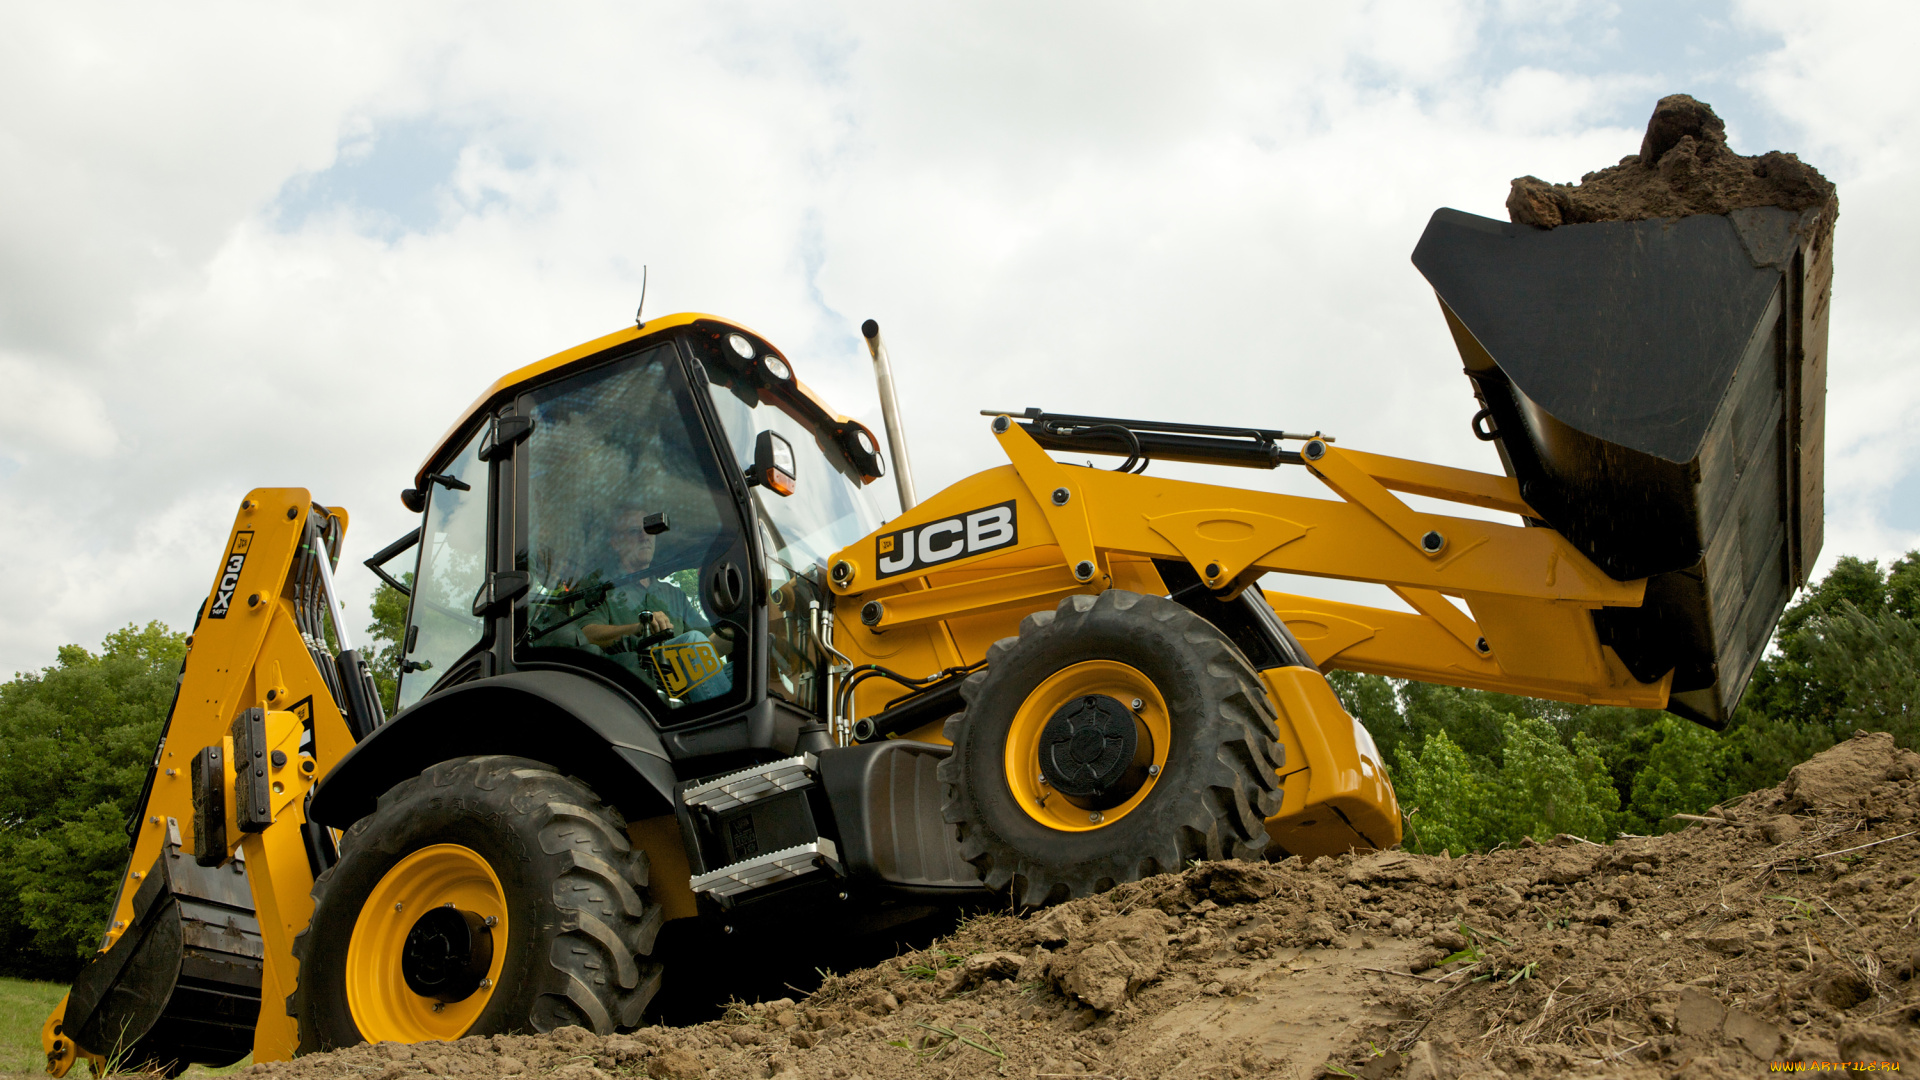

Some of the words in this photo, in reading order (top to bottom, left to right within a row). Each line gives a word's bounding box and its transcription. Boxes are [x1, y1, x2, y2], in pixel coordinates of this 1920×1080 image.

[880, 507, 1014, 574] JCB
[212, 555, 245, 609] 3CX
[663, 645, 718, 692] JCB
[427, 797, 532, 862] GALAXY
